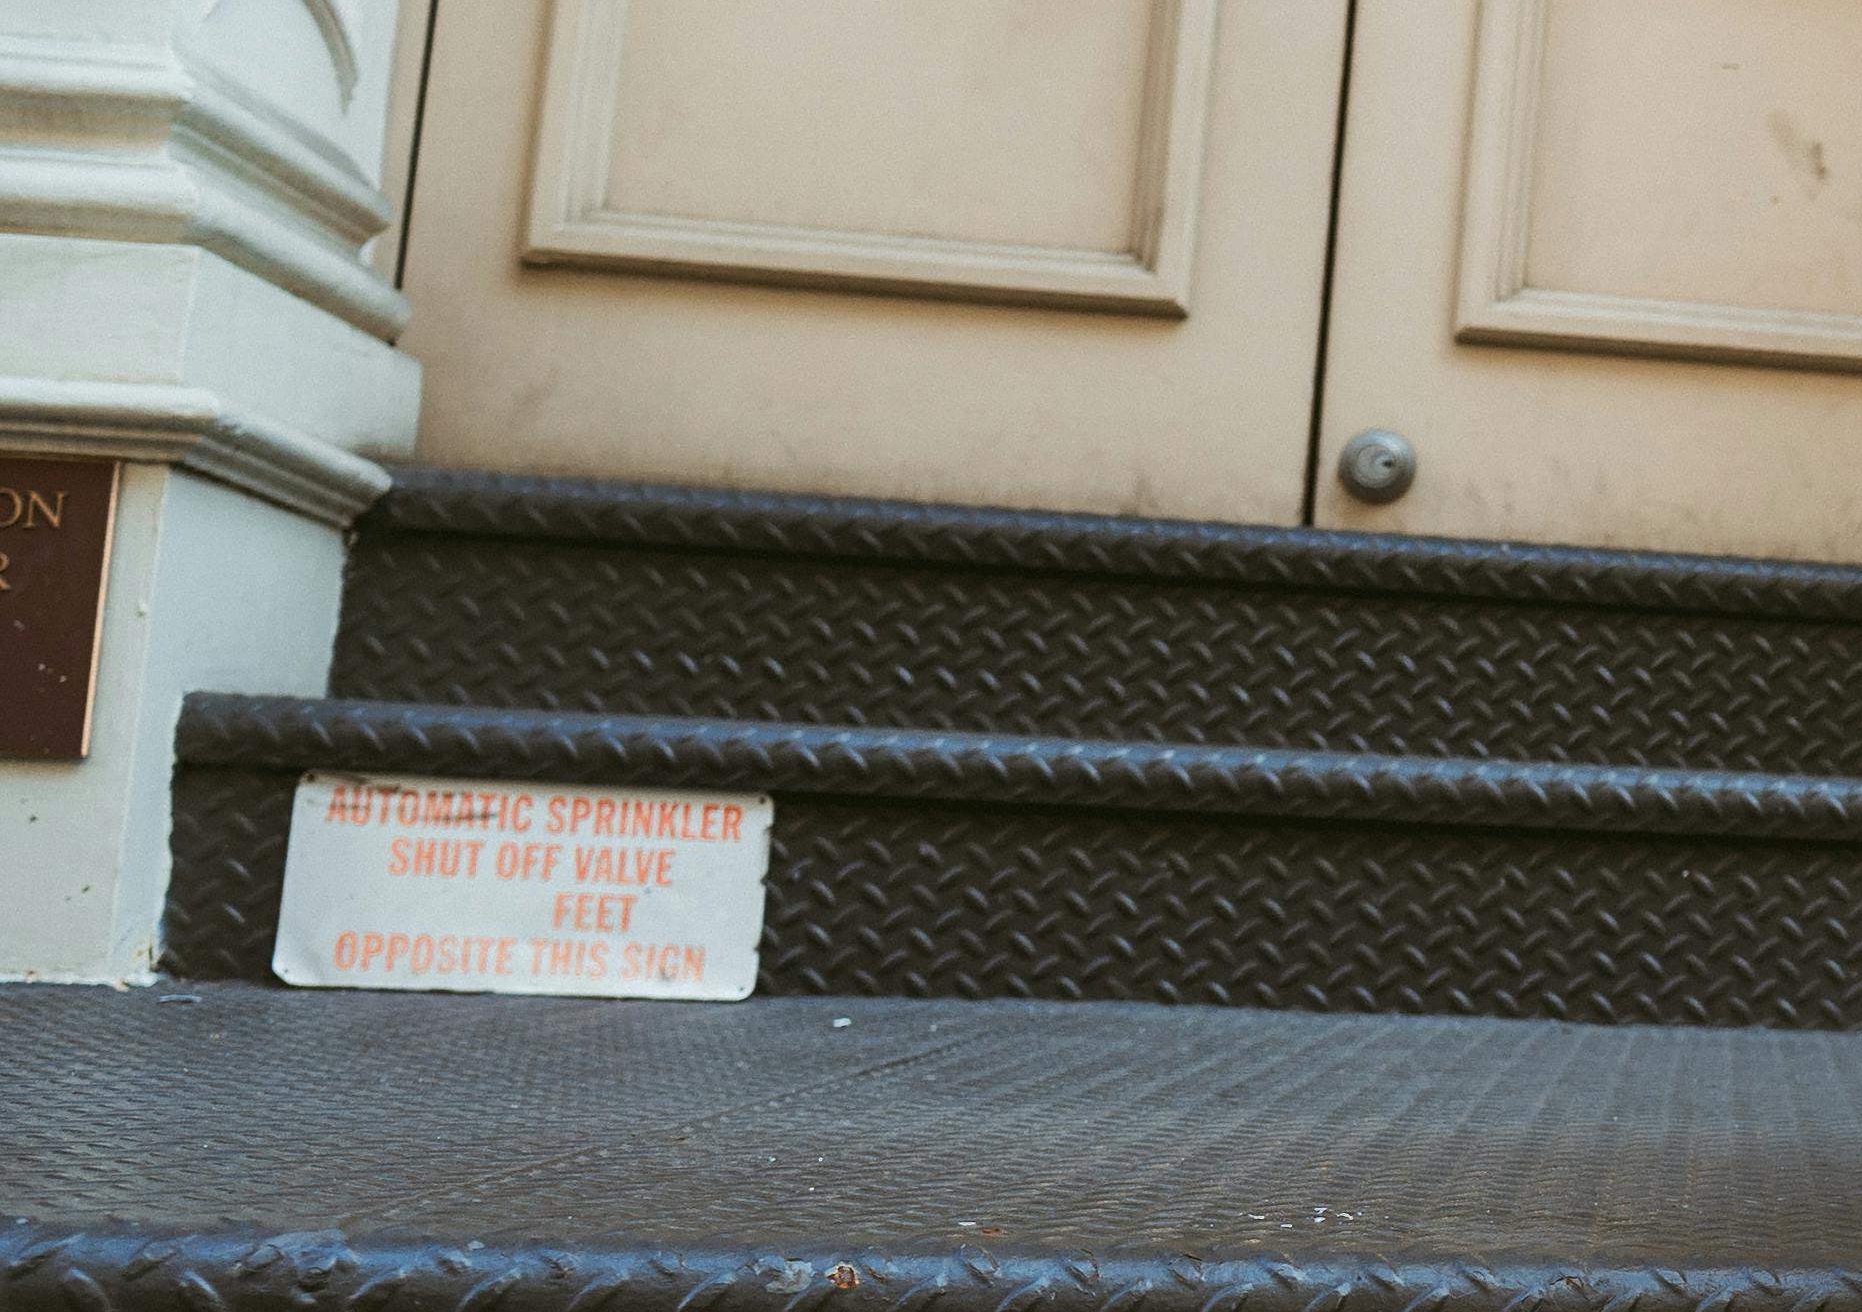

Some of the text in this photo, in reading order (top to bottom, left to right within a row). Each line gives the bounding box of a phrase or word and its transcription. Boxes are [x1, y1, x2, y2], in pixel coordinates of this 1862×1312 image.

[325, 785, 743, 841] AUTOMATIC SPRINKLER
[387, 837, 676, 886] SHUT OFF VALVE
[553, 892, 638, 932] FEET
[333, 930, 706, 982] OPPOSITE THIS SIGN
